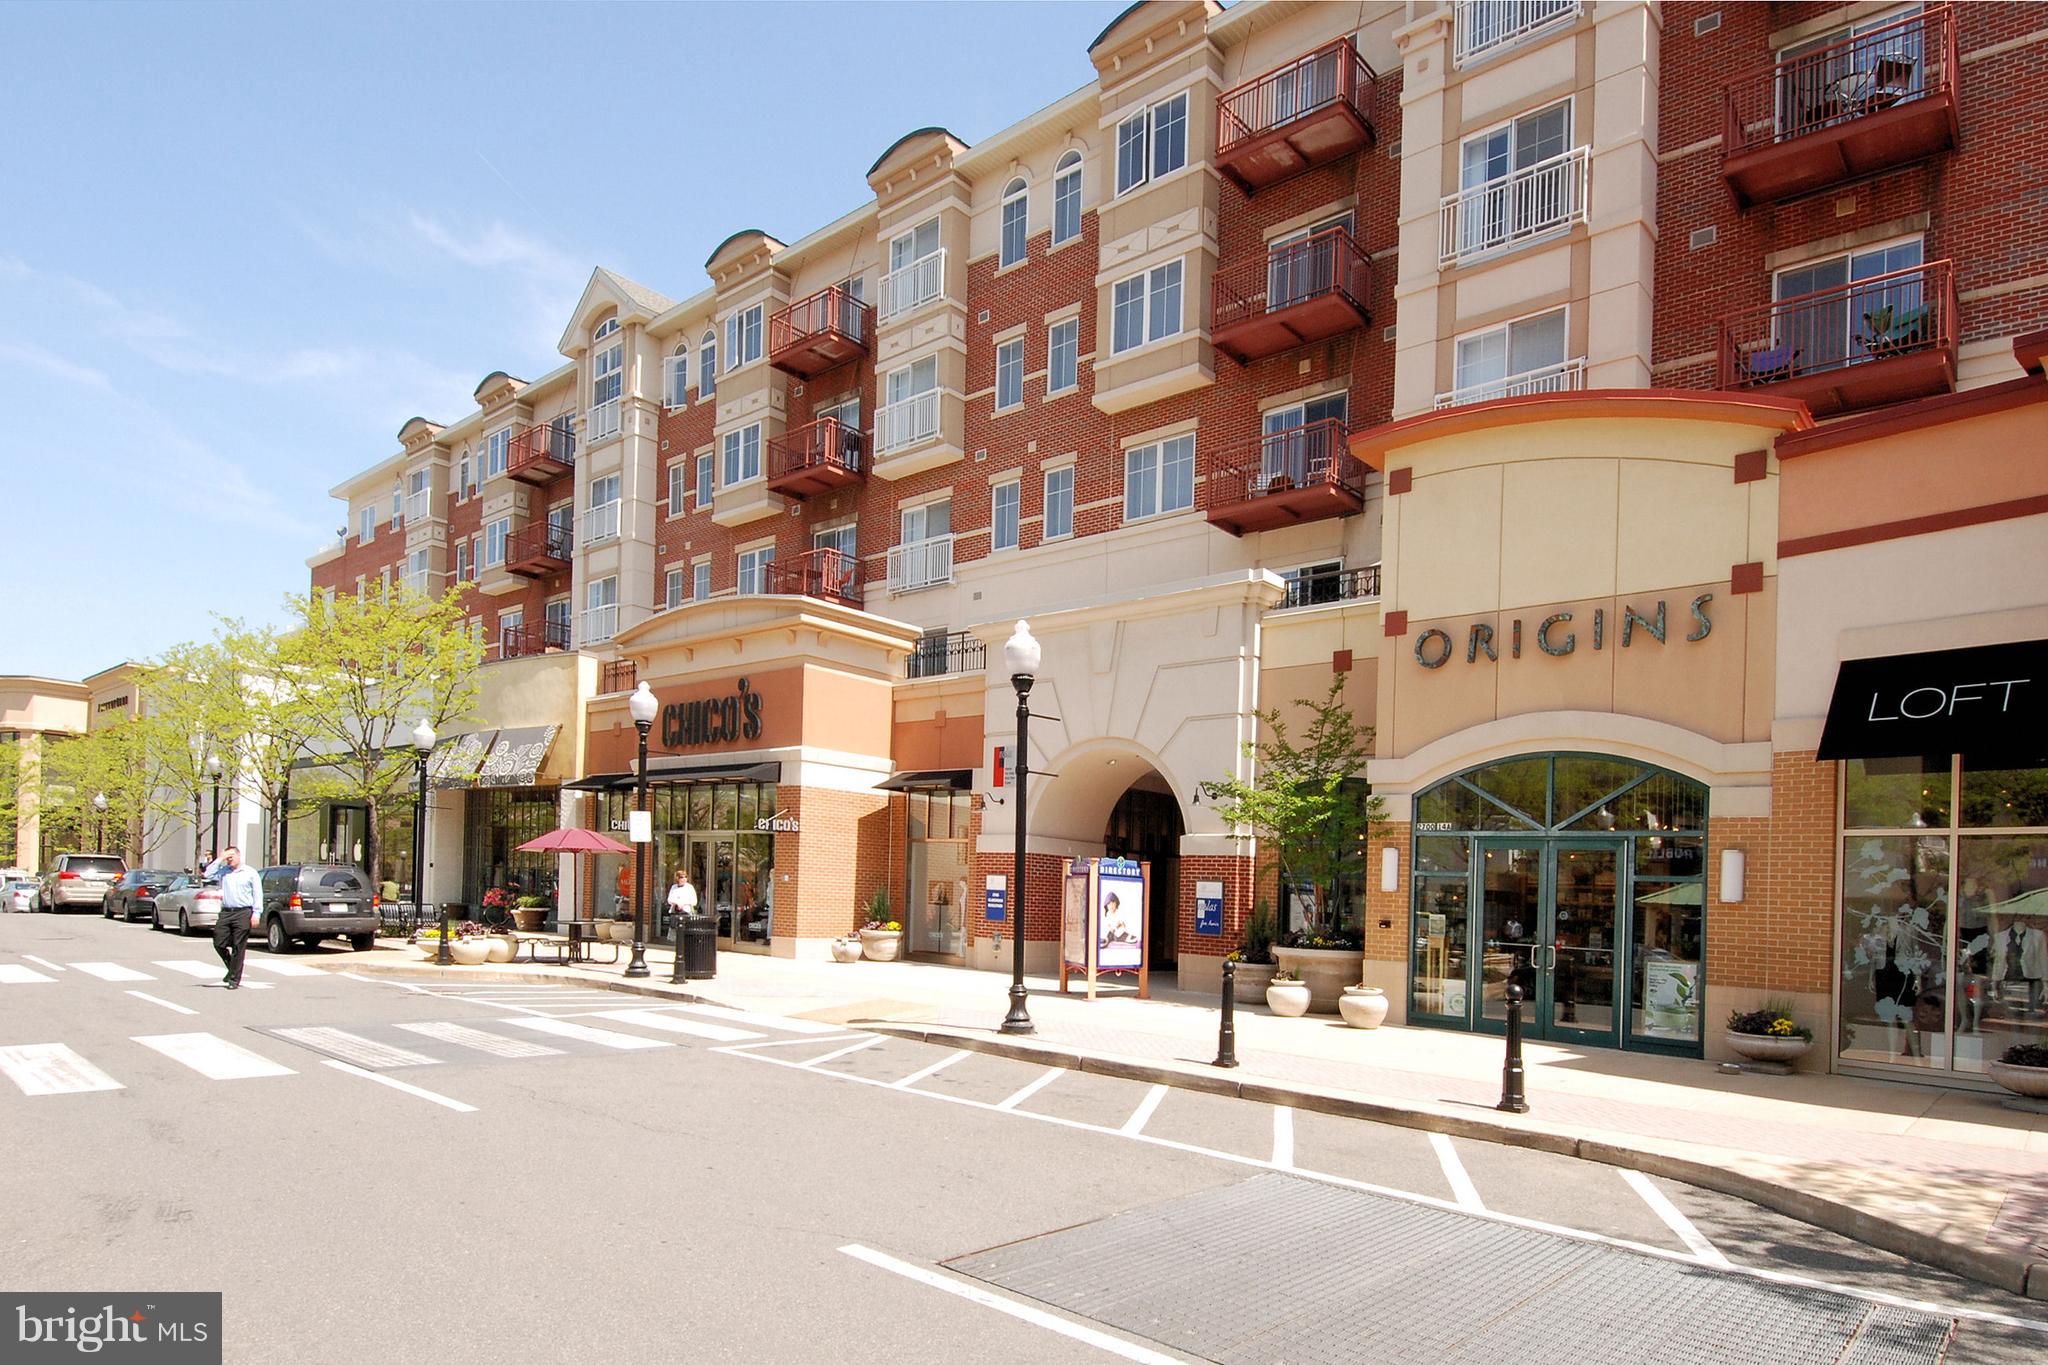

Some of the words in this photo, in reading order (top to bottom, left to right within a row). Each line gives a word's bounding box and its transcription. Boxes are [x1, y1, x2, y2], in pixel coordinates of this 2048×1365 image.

[1414, 593, 1713, 669] ORIGINS
[661, 677, 763, 747] CHICO'S
[1868, 678, 2032, 722] LOFT
[1100, 865, 1141, 877] DIRECTORY
